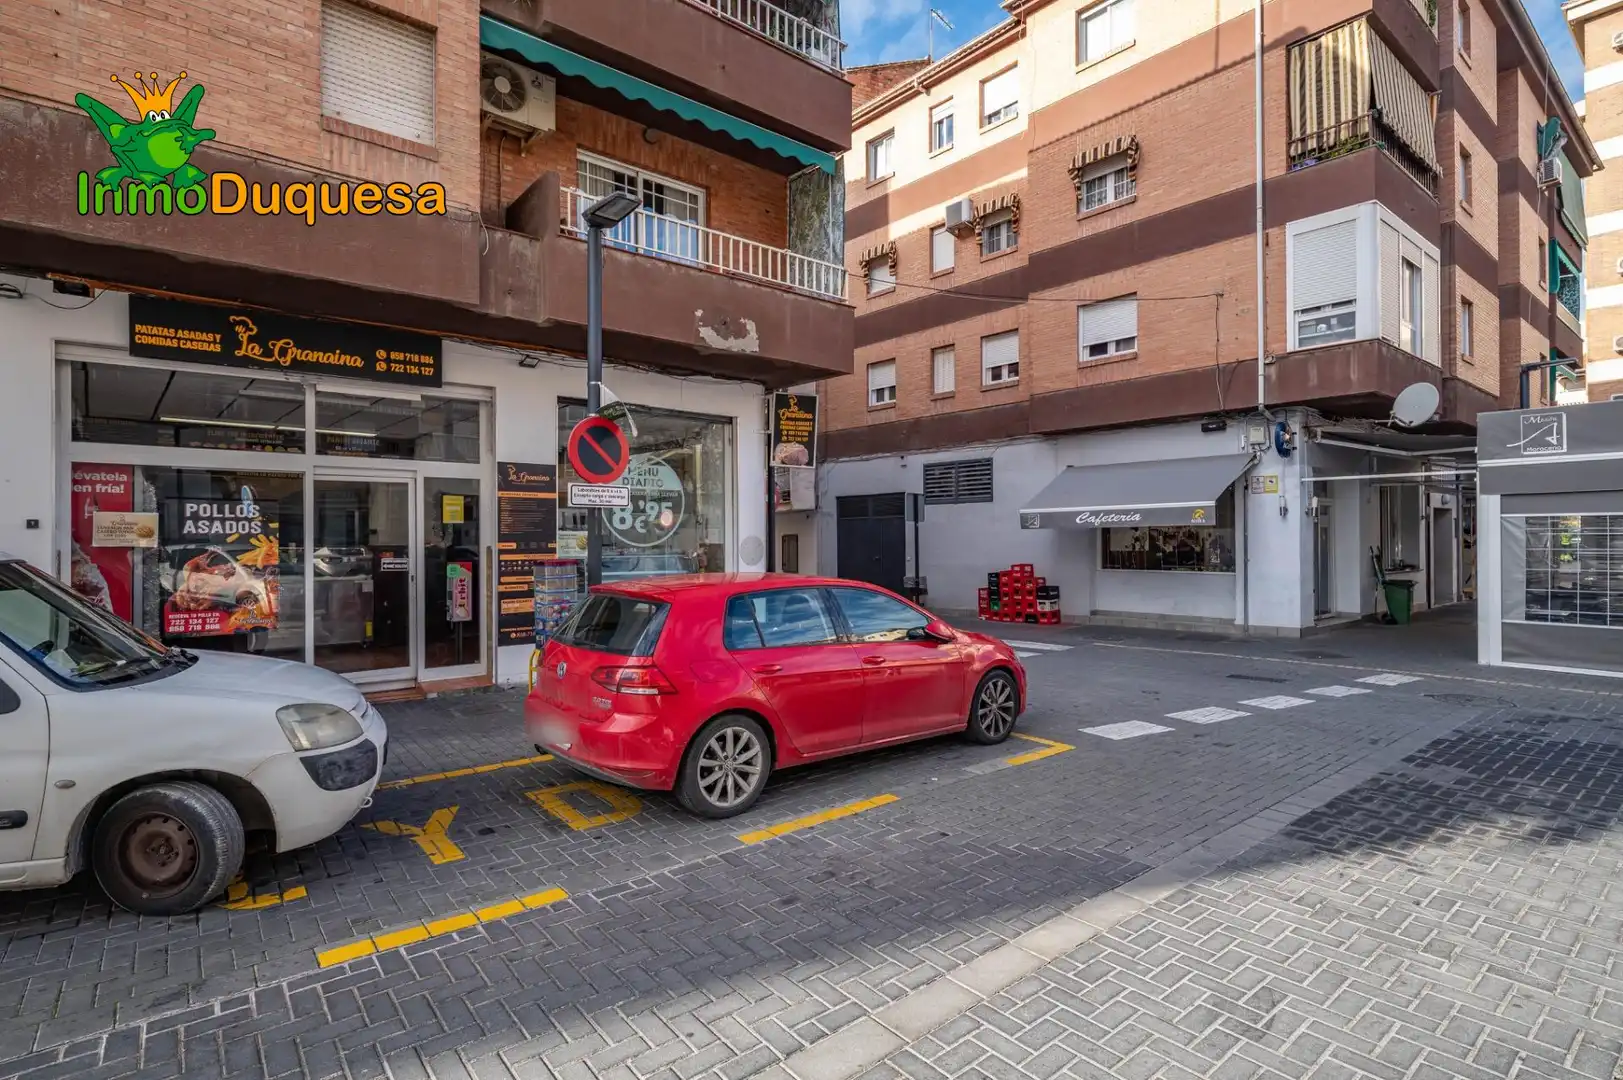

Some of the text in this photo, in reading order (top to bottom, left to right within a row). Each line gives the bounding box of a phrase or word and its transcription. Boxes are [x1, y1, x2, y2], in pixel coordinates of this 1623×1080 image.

[135, 324, 221, 343] PATATAS ASADAS Y
[135, 334, 222, 353] COMIDAS CASERAS
[390, 363, 404, 373] 722
[420, 367, 434, 376] 127
[72, 470, 127, 481] évatela
[184, 503, 260, 518] POLLOS
[182, 519, 262, 534] ASADOS
